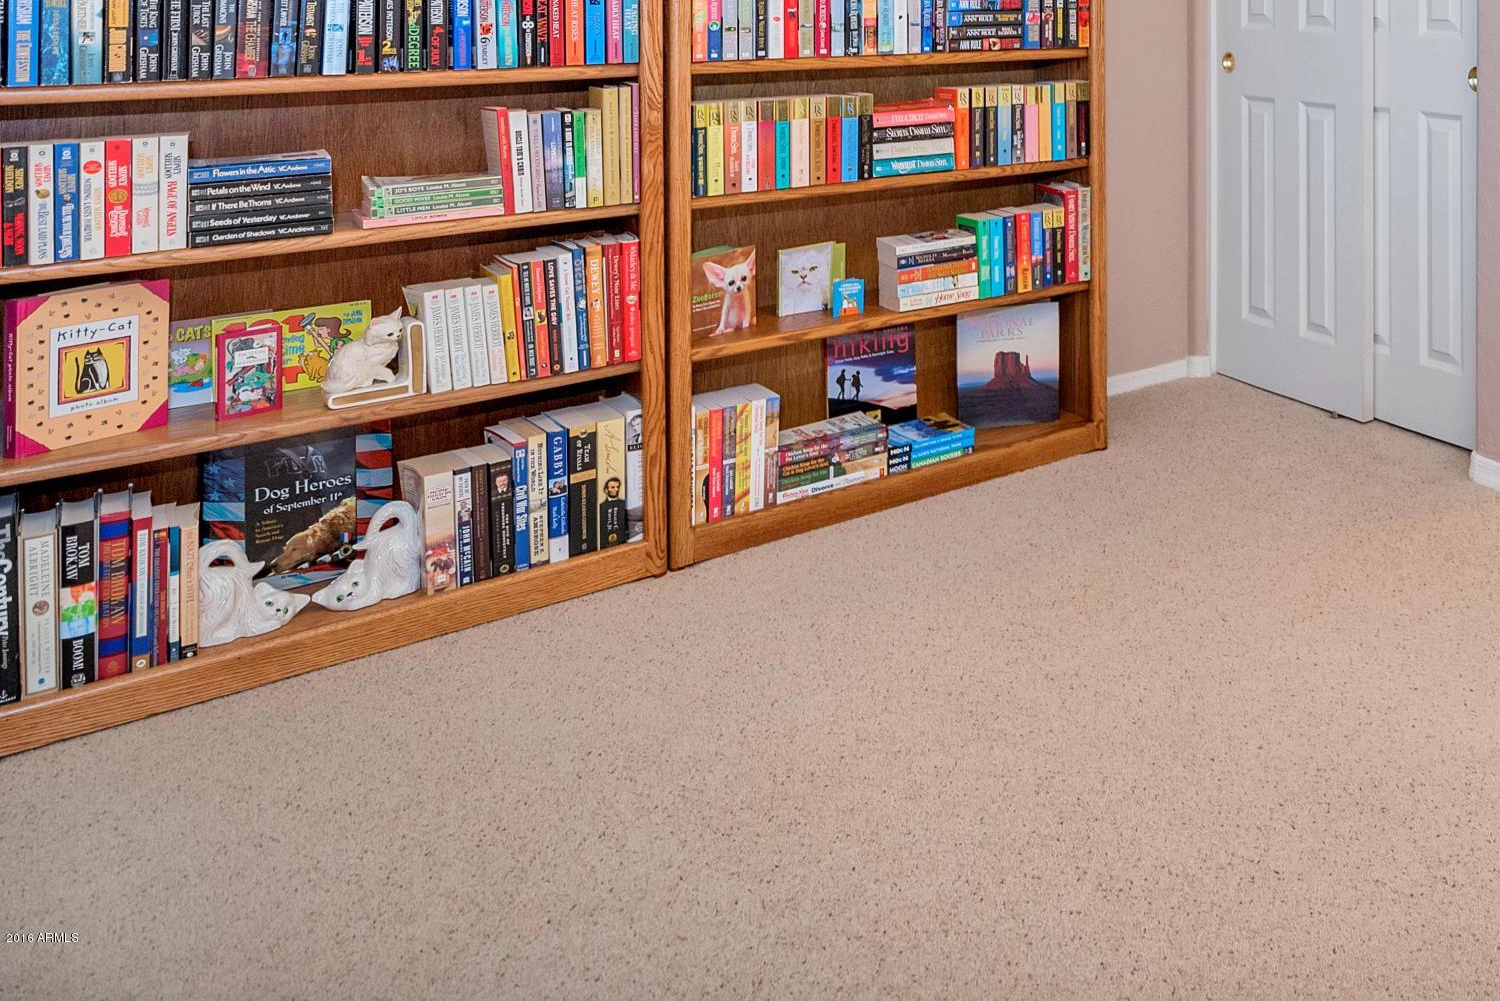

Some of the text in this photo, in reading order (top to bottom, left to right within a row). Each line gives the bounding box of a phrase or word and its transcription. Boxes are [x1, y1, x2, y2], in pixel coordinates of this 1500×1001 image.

[192, 5, 201, 25] JUROR
[201, 1, 210, 28] THE LAST
[358, 0, 372, 34] PATTERSON
[959, 0, 981, 9] ANN RULE
[149, 11, 158, 28] KING
[171, 11, 181, 30] FIRM
[538, 13, 547, 43] WAVE
[612, 20, 620, 40] HEAT
[245, 20, 257, 61] THE CHAMBER
[408, 29, 420, 68] DEGREE
[970, 40, 982, 49] RULE
[140, 47, 149, 79] GRISHAM
[149, 54, 158, 72] JOHN
[191, 46, 200, 77] GRISHAM
[201, 52, 210, 71] JOHN
[215, 45, 223, 75] GRISHAM
[224, 52, 232, 70] JOHN
[516, 146, 524, 161] TOM'S
[5, 165, 15, 193] SHELDON
[35, 163, 44, 187] SHELDON
[213, 169, 239, 177] Flowers
[258, 165, 276, 173] Attic
[517, 162, 525, 176] CABIN
[207, 186, 228, 195] Petals
[240, 185, 251, 193] the
[252, 183, 271, 191] Wind
[167, 181, 177, 237] RAGE OF ANGELS
[218, 202, 238, 210] There
[239, 200, 248, 208] Be
[249, 199, 272, 207] Thorns
[210, 215, 277, 227] Seeds of Yesterday
[213, 233, 239, 241] Garden
[247, 229, 275, 237] Shadows
[590, 259, 601, 294] DEWEY
[612, 256, 620, 278] Dewey's
[57, 320, 134, 342] Kitty-Cat
[176, 326, 212, 342] CATS
[432, 307, 445, 354] JAMES HERRIOT
[451, 306, 463, 353] JAMES HERRIOT
[470, 303, 484, 349] JAMES HERRIOT
[488, 301, 501, 348] JAMES HERRIOT
[832, 331, 911, 359] hiking
[70, 397, 118, 413] photo album
[552, 436, 564, 476] GABBY
[576, 440, 584, 471] OF RIVALS
[889, 463, 908, 473] MOON
[911, 451, 962, 468] CANADIAN ROCKIES
[254, 475, 352, 502] Dog Heroes
[811, 483, 834, 493] Divorce
[263, 505, 273, 515] of
[275, 495, 327, 513] September
[516, 485, 526, 531] Civil War Sites
[65, 536, 78, 580] BROKAW
[78, 542, 90, 567] TOM
[29, 547, 38, 597] ALBRIGHT
[40, 541, 50, 598] MADELEINE
[110, 541, 125, 625] TOM BROKAW
[72, 640, 85, 670] BOOM!
